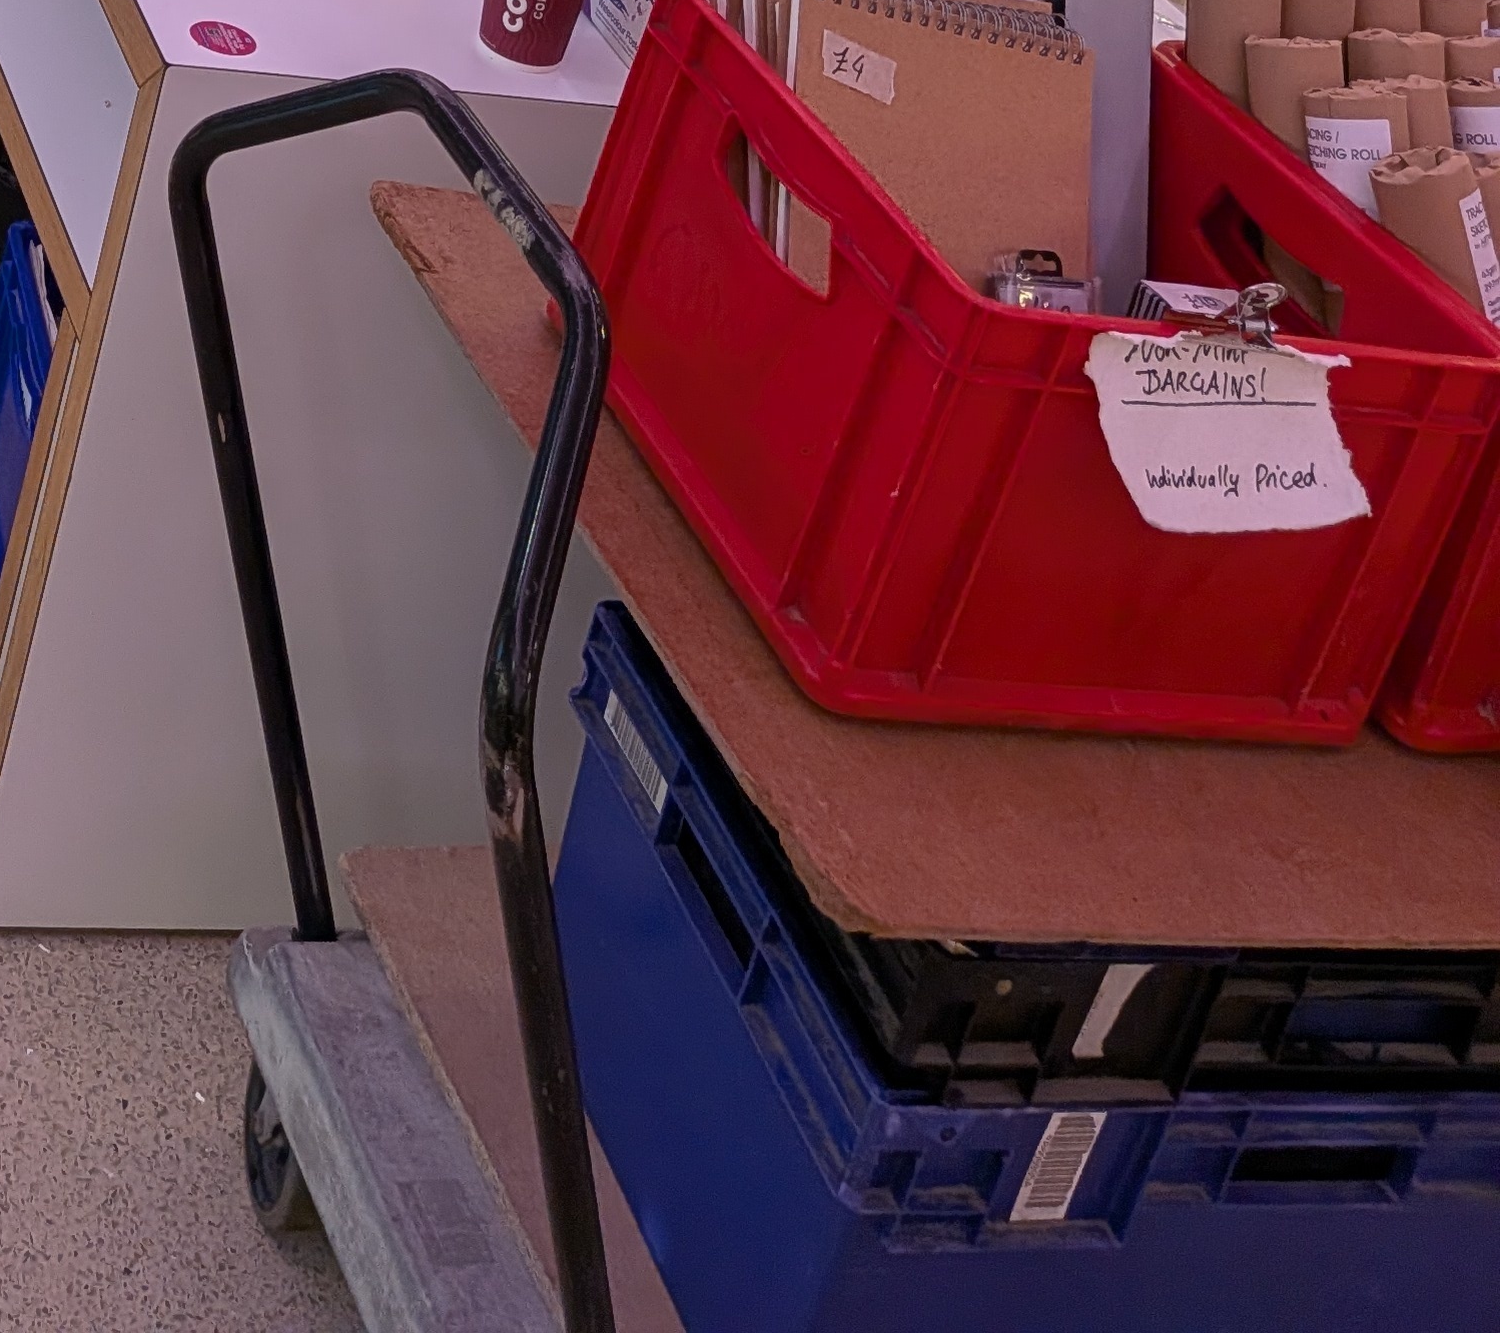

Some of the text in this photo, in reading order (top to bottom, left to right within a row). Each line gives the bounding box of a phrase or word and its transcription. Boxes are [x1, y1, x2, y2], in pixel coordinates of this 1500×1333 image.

[832, 47, 864, 82] £4
[1467, 134, 1497, 146] ROLL
[1351, 149, 1382, 161] ROLL
[1182, 293, 1221, 310] £10
[1135, 368, 1267, 402] BARGAINS!
[1146, 463, 1327, 497] Individually Priced.
